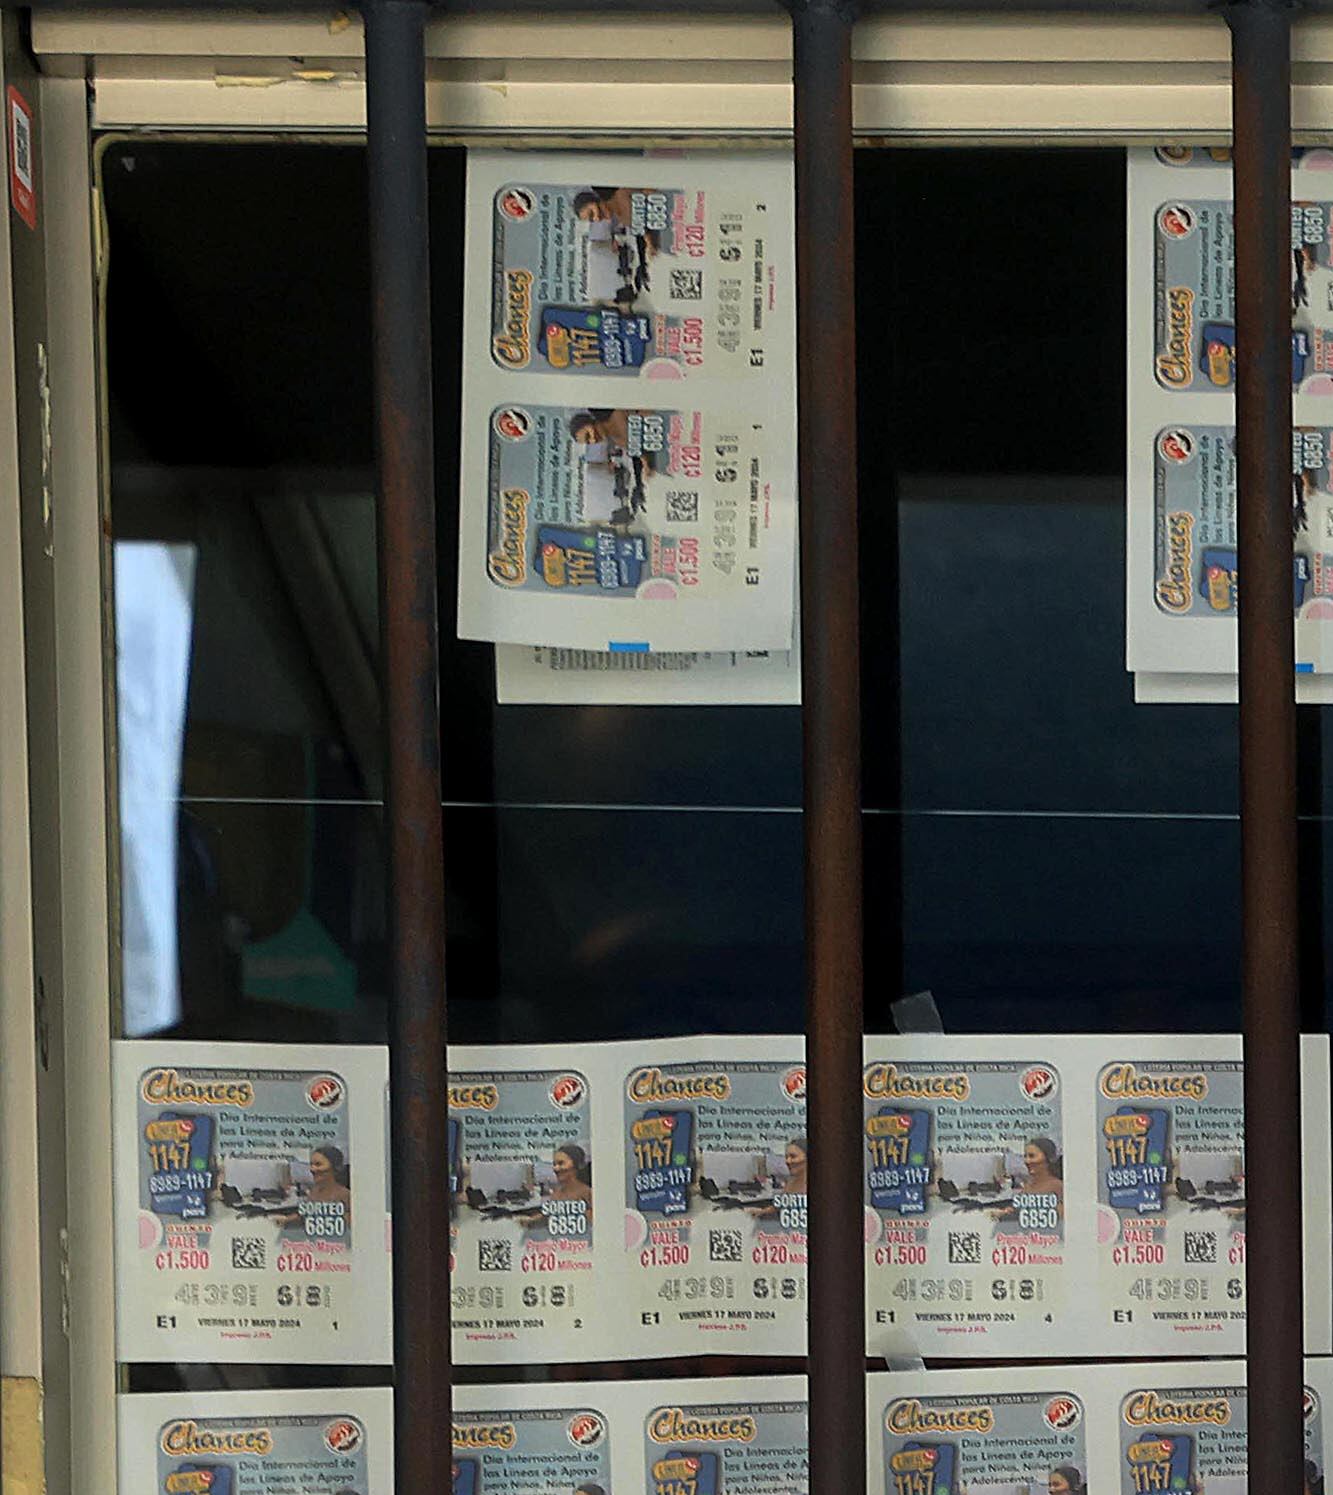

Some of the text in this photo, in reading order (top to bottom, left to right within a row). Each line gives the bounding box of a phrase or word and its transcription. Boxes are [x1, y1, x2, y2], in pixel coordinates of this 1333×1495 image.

[493, 267, 534, 368] Chances
[1156, 285, 1194, 386] Chances
[643, 417, 663, 452] 6850
[1304, 432, 1322, 468] 6850
[489, 486, 530, 586] Chances
[1156, 511, 1194, 611] Chances
[144, 1069, 253, 1108] Chances
[629, 1065, 730, 1104] Chances
[864, 1064, 970, 1101] Chances
[1103, 1063, 1207, 1101] Chances
[868, 1136, 909, 1166] 1147
[869, 1168, 930, 1189] 8989-1147
[298, 1202, 344, 1216] SORTEO
[1013, 1195, 1057, 1208] SORTEO
[1019, 1209, 1057, 1227] 6850
[305, 1216, 344, 1235] 6850
[876, 1311, 895, 1322] E1
[651, 1406, 756, 1446] Chances
[888, 1397, 994, 1437] Chances
[163, 1419, 272, 1458] Chances
